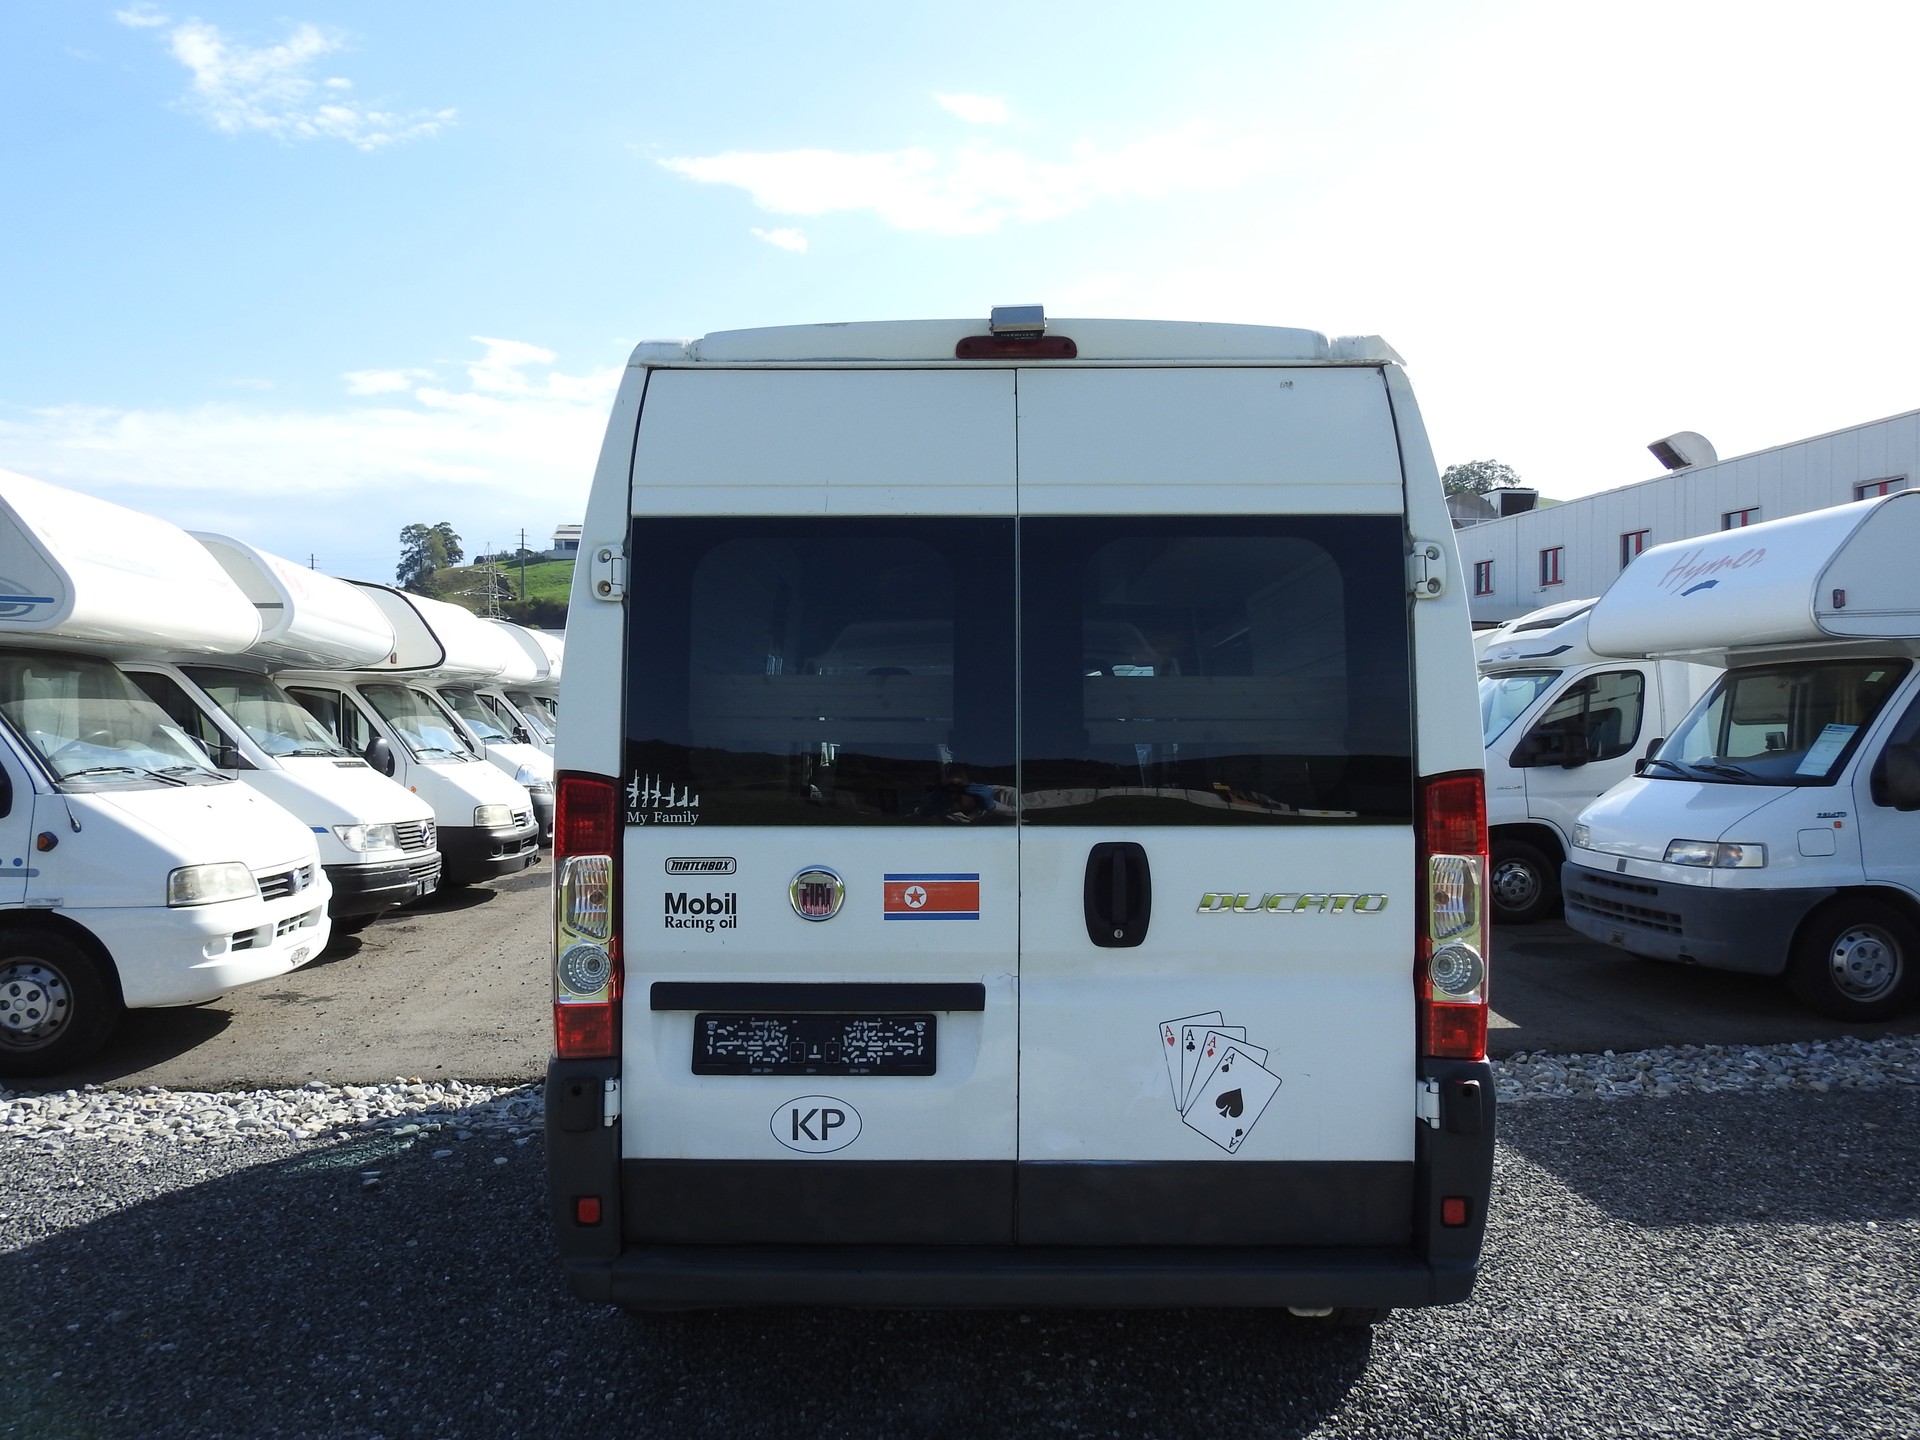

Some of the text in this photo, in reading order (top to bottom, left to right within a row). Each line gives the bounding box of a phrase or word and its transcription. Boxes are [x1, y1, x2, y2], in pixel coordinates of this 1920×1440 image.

[626, 810, 700, 826] My Family
[670, 860, 731, 871] MATCHBOX
[802, 883, 833, 907] FIAT
[664, 892, 737, 915] Mobil
[1196, 892, 1389, 915] DUCATO
[664, 915, 737, 934] Racing oil
[1164, 1025, 1174, 1037] A
[1185, 1029, 1195, 1041] A
[1207, 1036, 1217, 1048] A
[1225, 1053, 1236, 1065] A
[791, 1108, 846, 1141] KP
[1228, 1137, 1239, 1149] A
